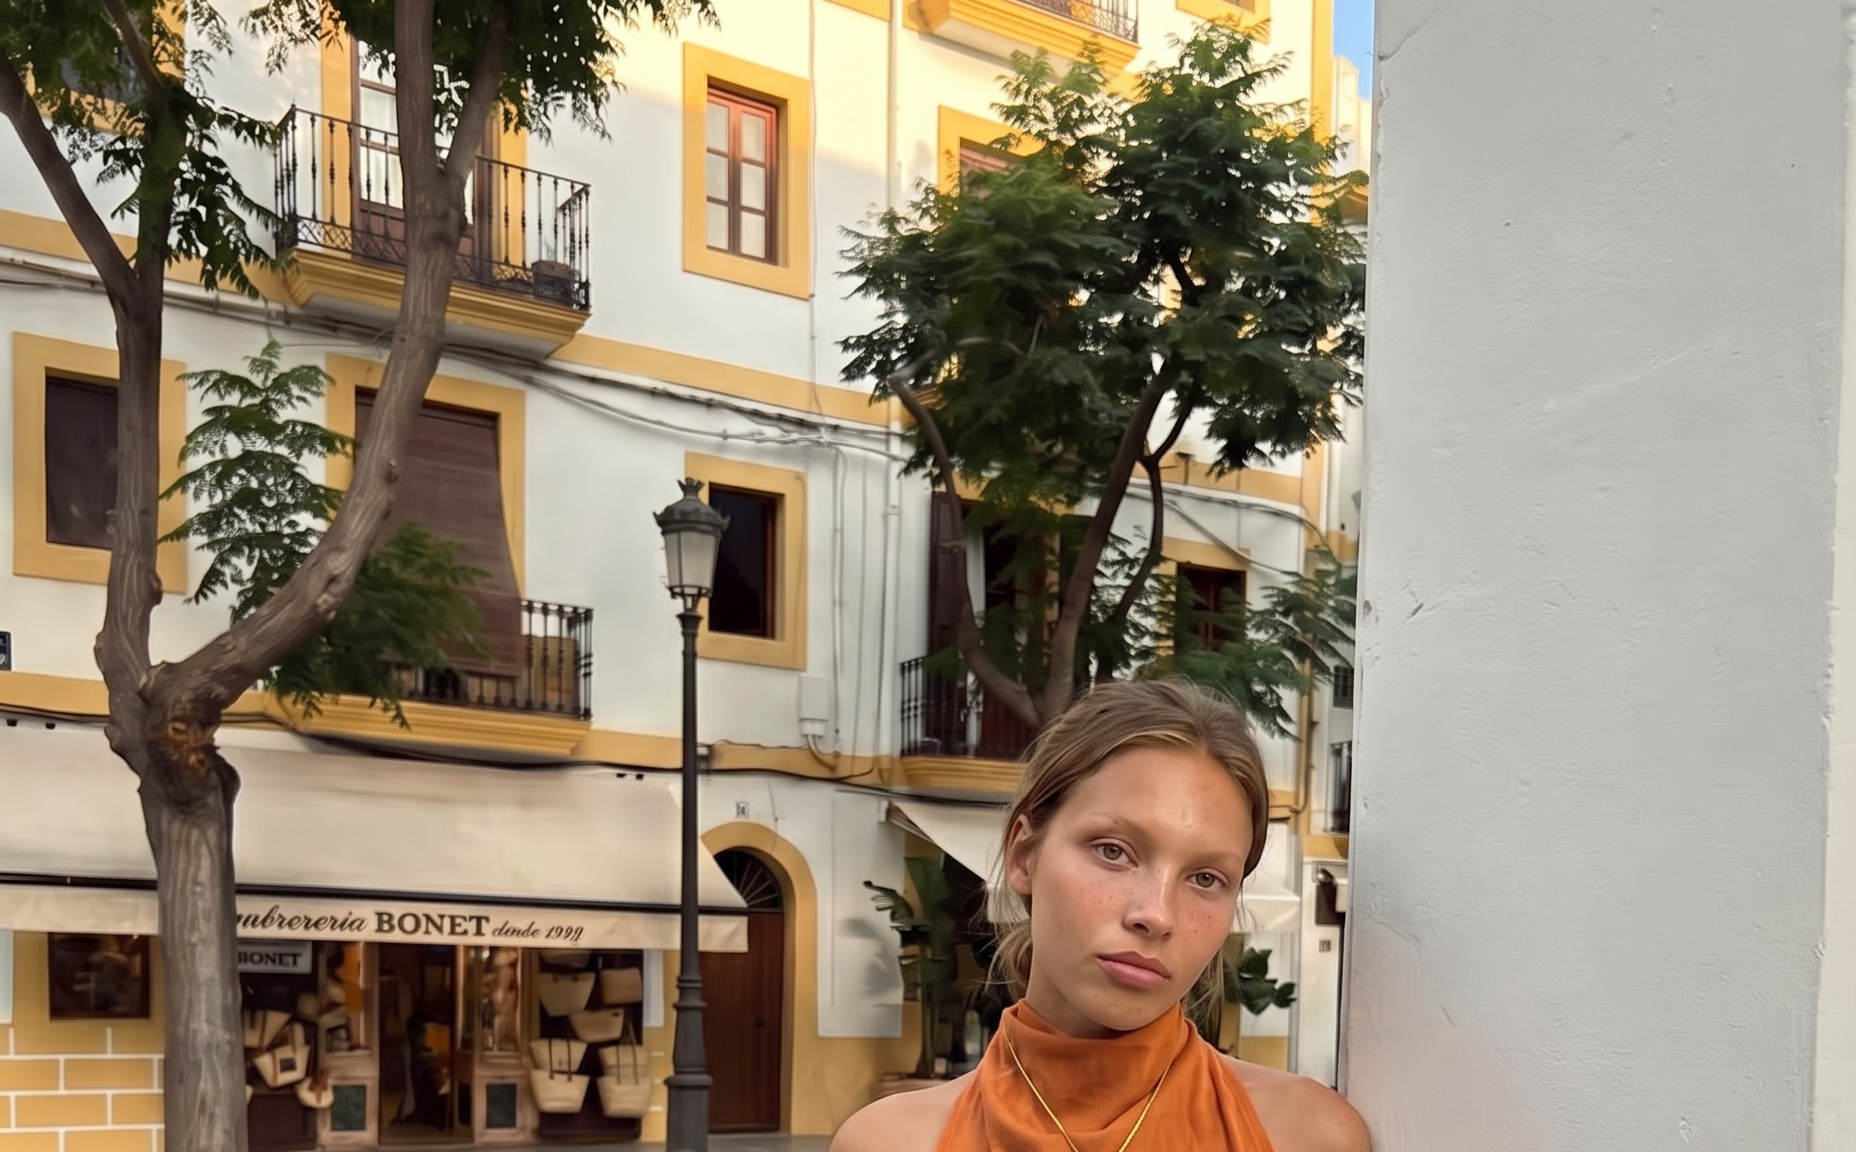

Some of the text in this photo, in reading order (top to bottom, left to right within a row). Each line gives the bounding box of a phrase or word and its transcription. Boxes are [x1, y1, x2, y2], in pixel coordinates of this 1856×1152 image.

[236, 904, 367, 932] mbrereria
[374, 911, 490, 937] BONET
[238, 951, 302, 967] BONET
